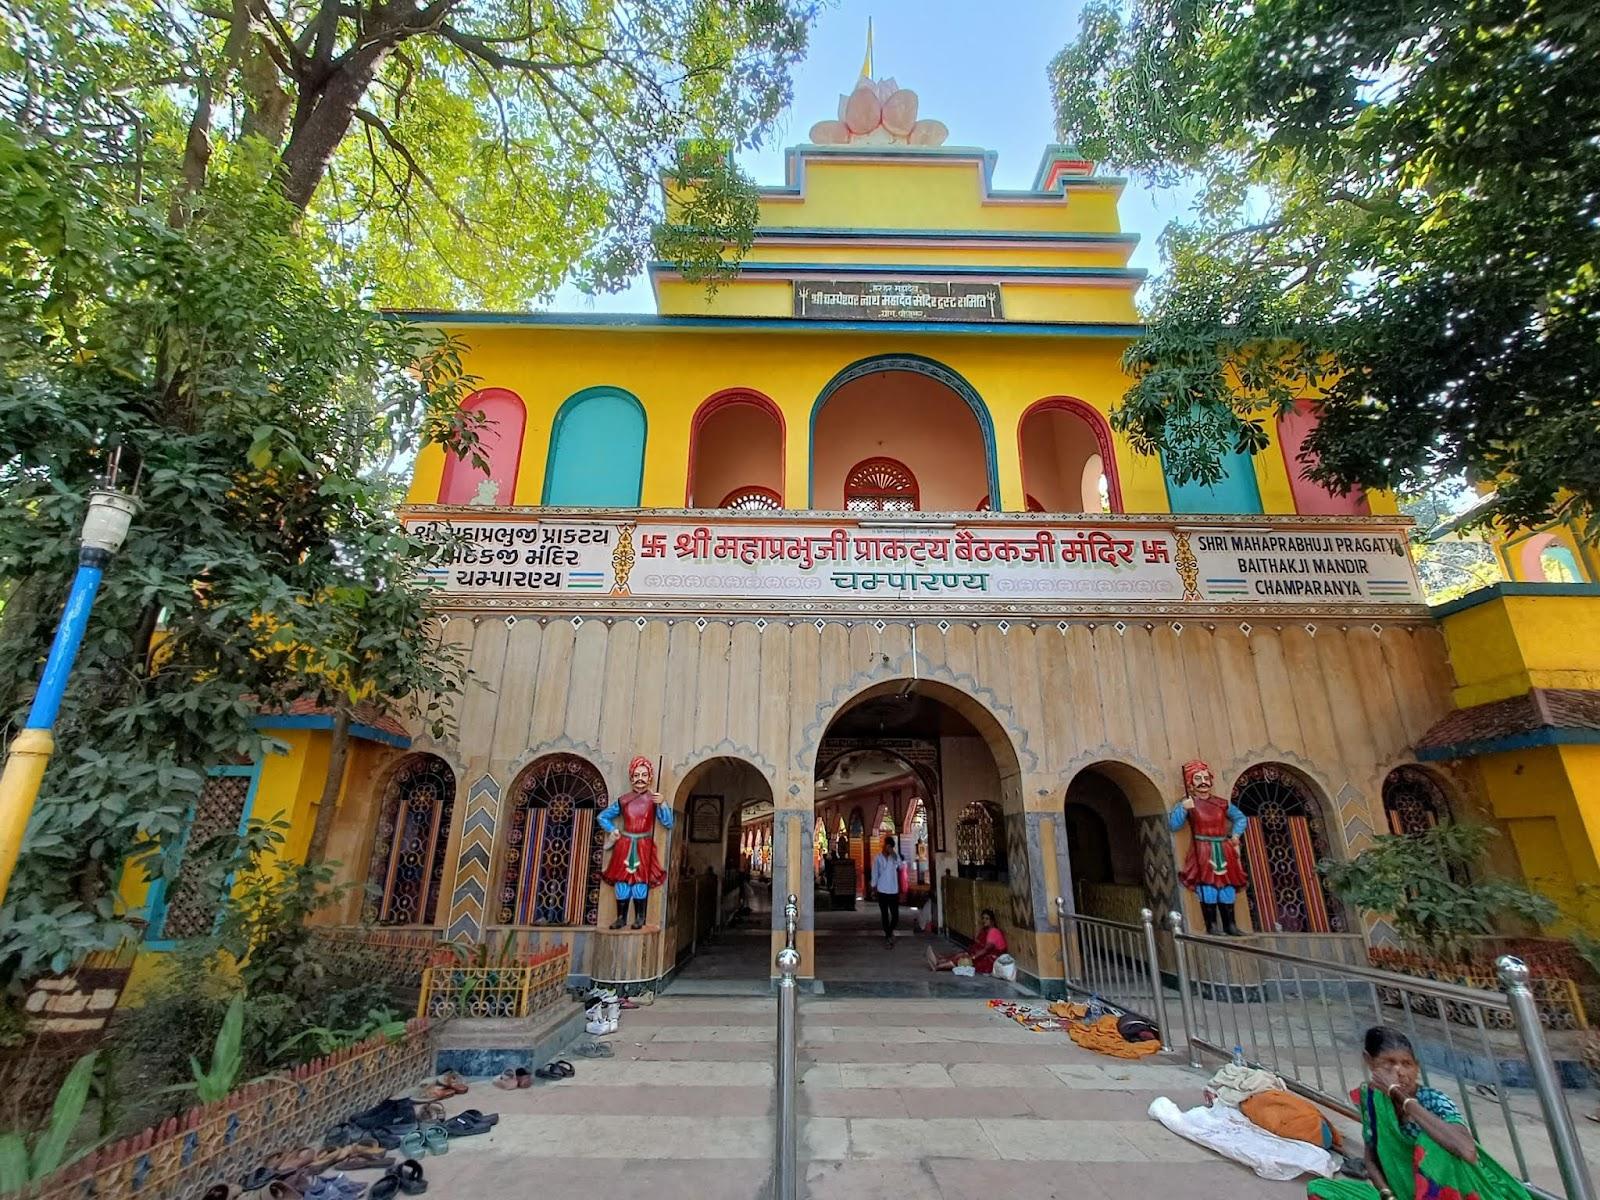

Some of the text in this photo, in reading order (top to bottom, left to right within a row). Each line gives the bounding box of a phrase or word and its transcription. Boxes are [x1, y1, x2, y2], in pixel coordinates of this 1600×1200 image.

[811, 291, 823, 305] श्री
[860, 294, 880, 307] नाथ
[881, 293, 912, 307] महादेव
[913, 293, 937, 308] मंदिर
[958, 294, 987, 308] समिति
[673, 527, 712, 559] श्री
[713, 528, 850, 569] महाप्रभुजी
[954, 529, 1056, 563] बैठकजी
[1060, 531, 1135, 567] मंदिर
[1198, 536, 1229, 551] SHRI
[1231, 536, 1333, 554] MAHAPRABHUJI
[525, 545, 579, 566] મંદિર
[1238, 558, 1369, 574] BAITHAKJI MANDIR
[456, 570, 562, 589] ચમ્પારણ્ય
[830, 571, 990, 592] चम्पारण्य
[1255, 580, 1362, 596] CHAMPARANYA
